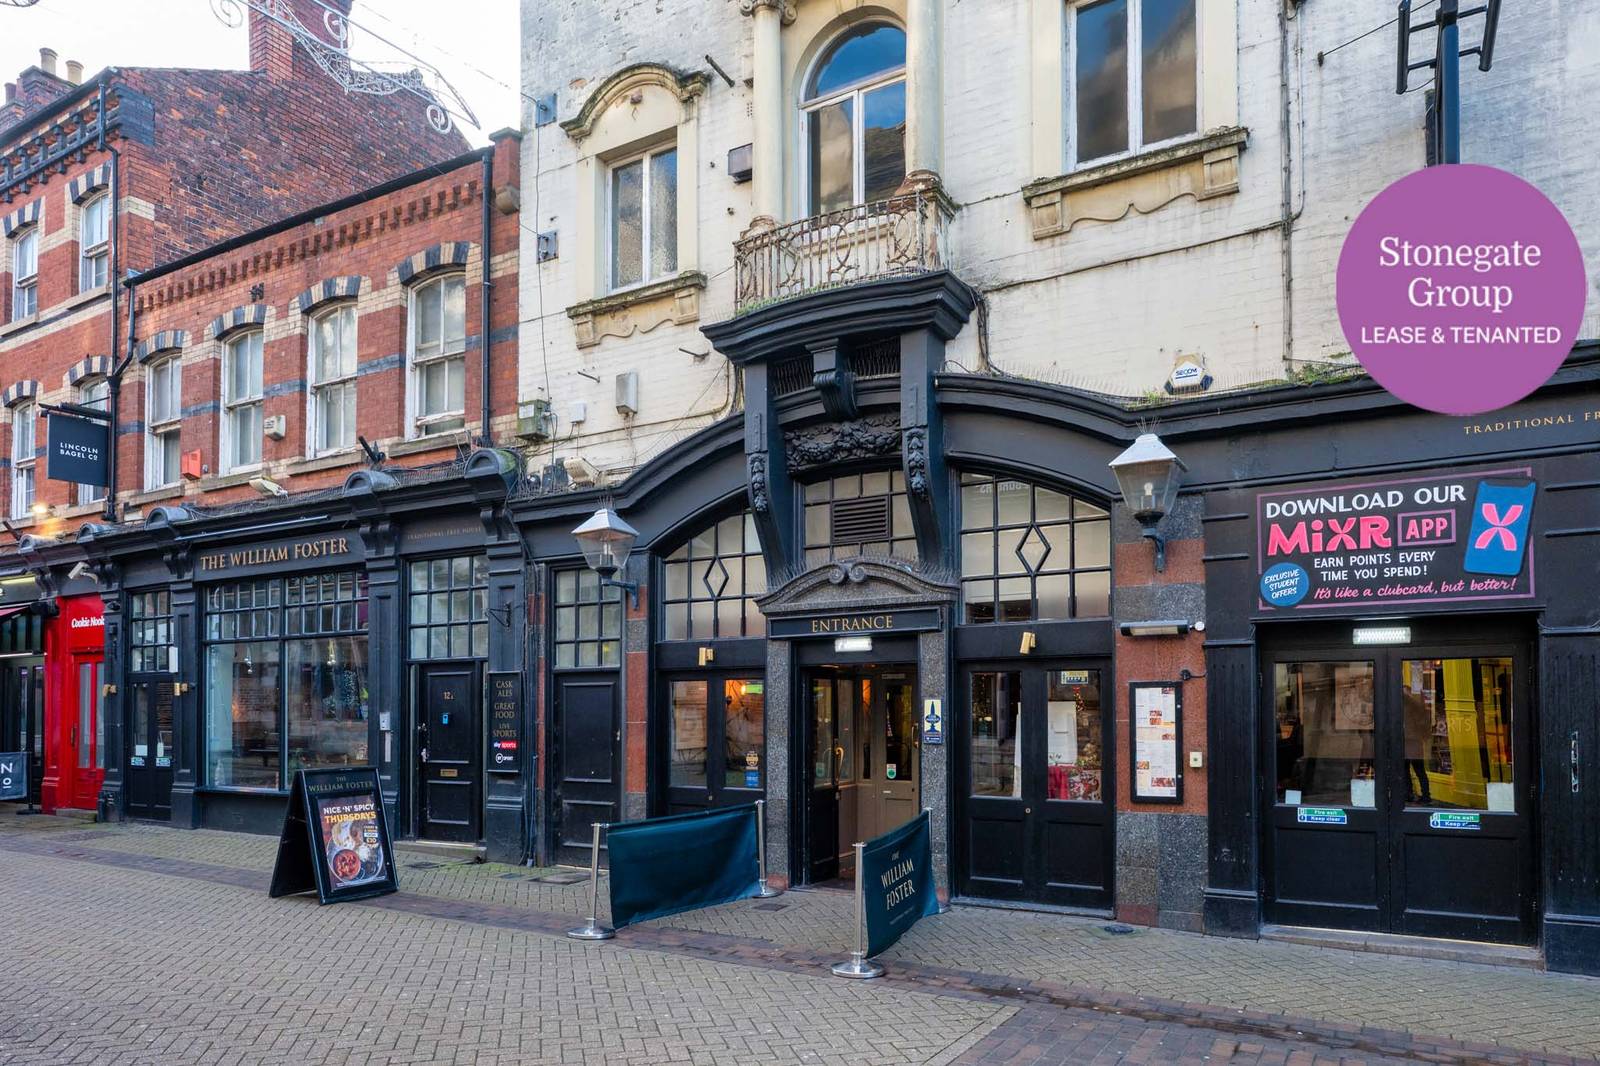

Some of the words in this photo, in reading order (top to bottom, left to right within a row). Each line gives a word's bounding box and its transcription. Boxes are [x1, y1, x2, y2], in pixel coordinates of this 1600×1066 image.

[1463, 414, 1575, 435] TRADITIONAL
[60, 442, 98, 454] LINCOLN
[60, 449, 86, 459] BAGEL
[1266, 490, 1404, 518] DOWNLOAD
[1414, 485, 1467, 504] OUR
[1267, 515, 1392, 556] MiXR
[1405, 517, 1448, 540] APP
[200, 554, 226, 570] THE
[230, 546, 288, 566] WILLIAM
[294, 537, 349, 559] FOSTER
[1314, 558, 1344, 569] EARN
[1350, 553, 1391, 566] POINTS
[1399, 551, 1436, 563] EVERY
[1264, 569, 1300, 584] EXCLUSIVE
[1321, 570, 1348, 581] TIME
[1354, 568, 1378, 579] YOU
[1383, 565, 1428, 578] SPEND!
[1269, 578, 1300, 591] STUDENT
[1314, 587, 1332, 599] It's
[1335, 585, 1359, 598] like
[1363, 589, 1373, 597] a
[1377, 581, 1438, 596] clubcard,
[1441, 579, 1465, 592] but
[1470, 578, 1517, 591] better!
[1271, 587, 1297, 599] OFFERS
[71, 617, 90, 628] Cookie
[812, 615, 893, 633] ENTRANCE
[496, 680, 513, 688] CASK
[494, 702, 515, 710] GREAT
[309, 783, 343, 791] WILLIAM
[346, 781, 374, 789] FOSTER
[323, 806, 341, 815] NICE
[354, 802, 375, 811] SPICY
[324, 811, 377, 824] THURSDAYS
[881, 858, 914, 889] WILLIAM
[886, 879, 915, 911] FOSTER
